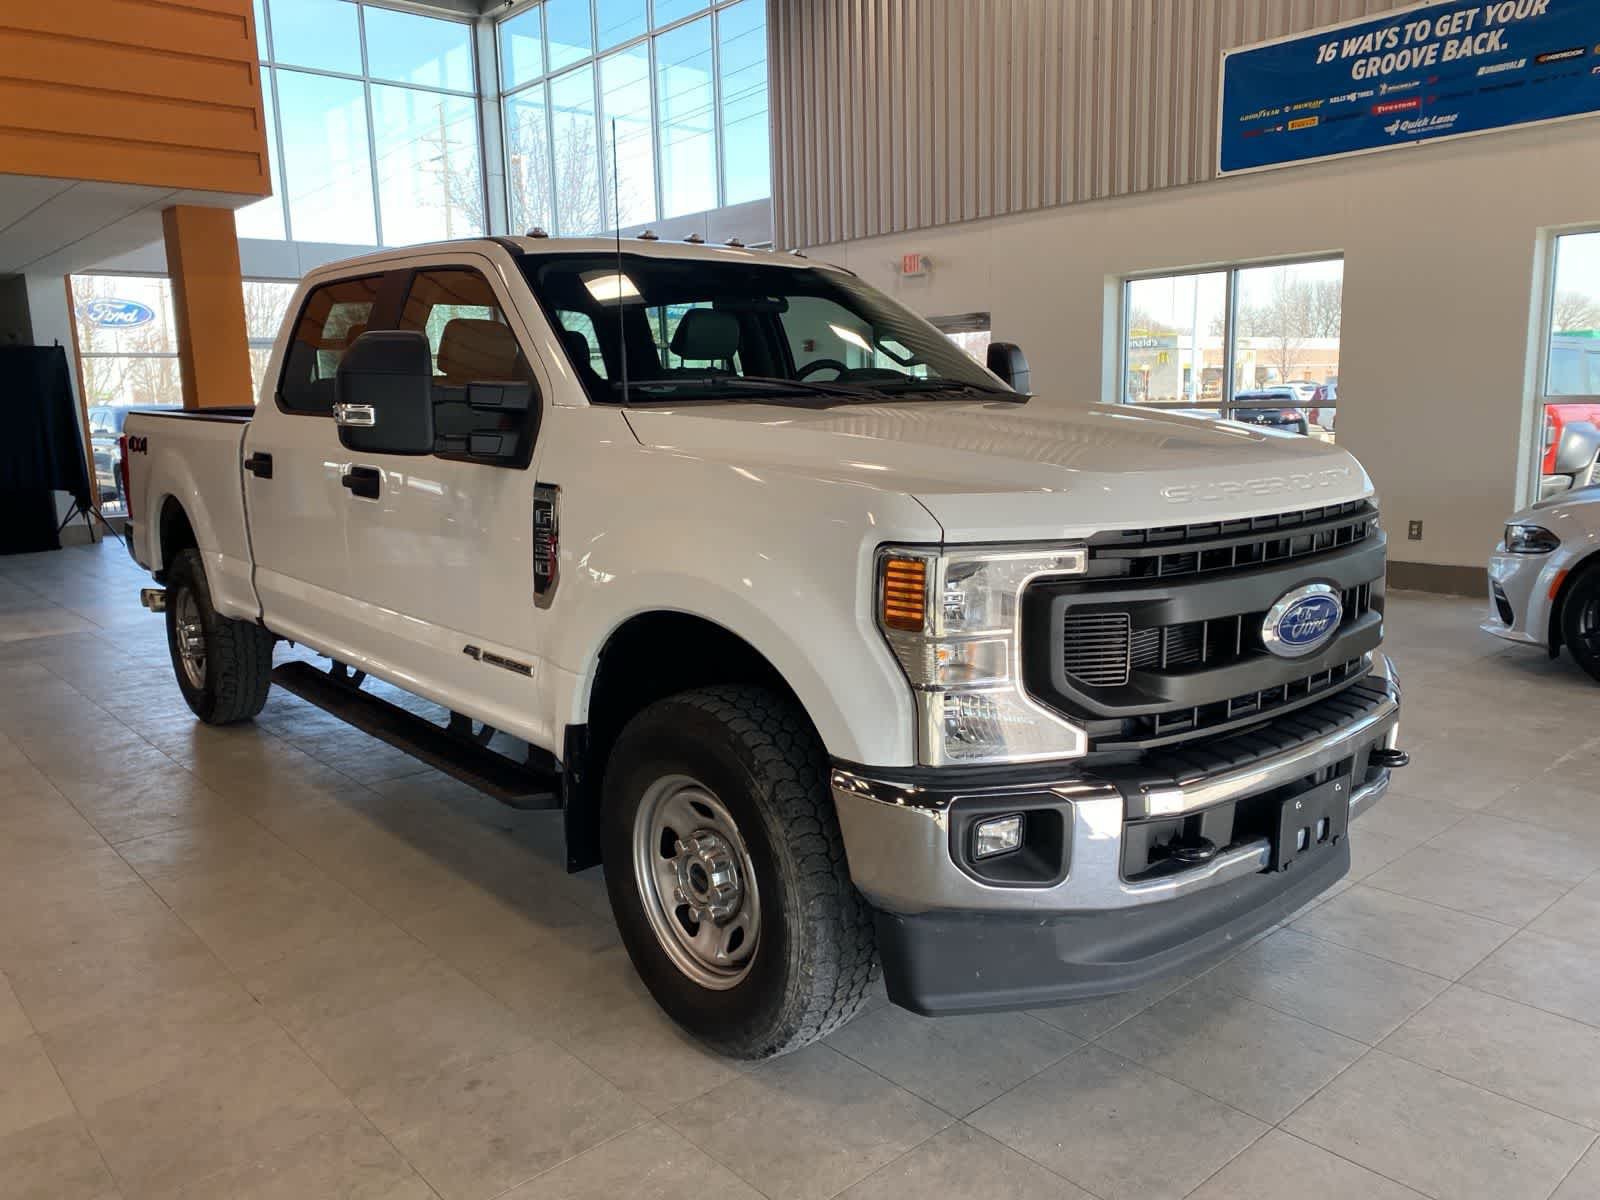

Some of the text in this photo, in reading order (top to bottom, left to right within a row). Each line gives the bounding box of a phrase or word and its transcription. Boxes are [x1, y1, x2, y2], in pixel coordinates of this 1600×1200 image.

[1316, 0, 1550, 64] 16 WAYS TO GET YOUR
[1351, 42, 1439, 80] GROOVE
[1441, 28, 1508, 62] BACK.
[1400, 115, 1428, 131] Quick
[1430, 112, 1458, 125] Lane
[1281, 604, 1331, 639] Ford
